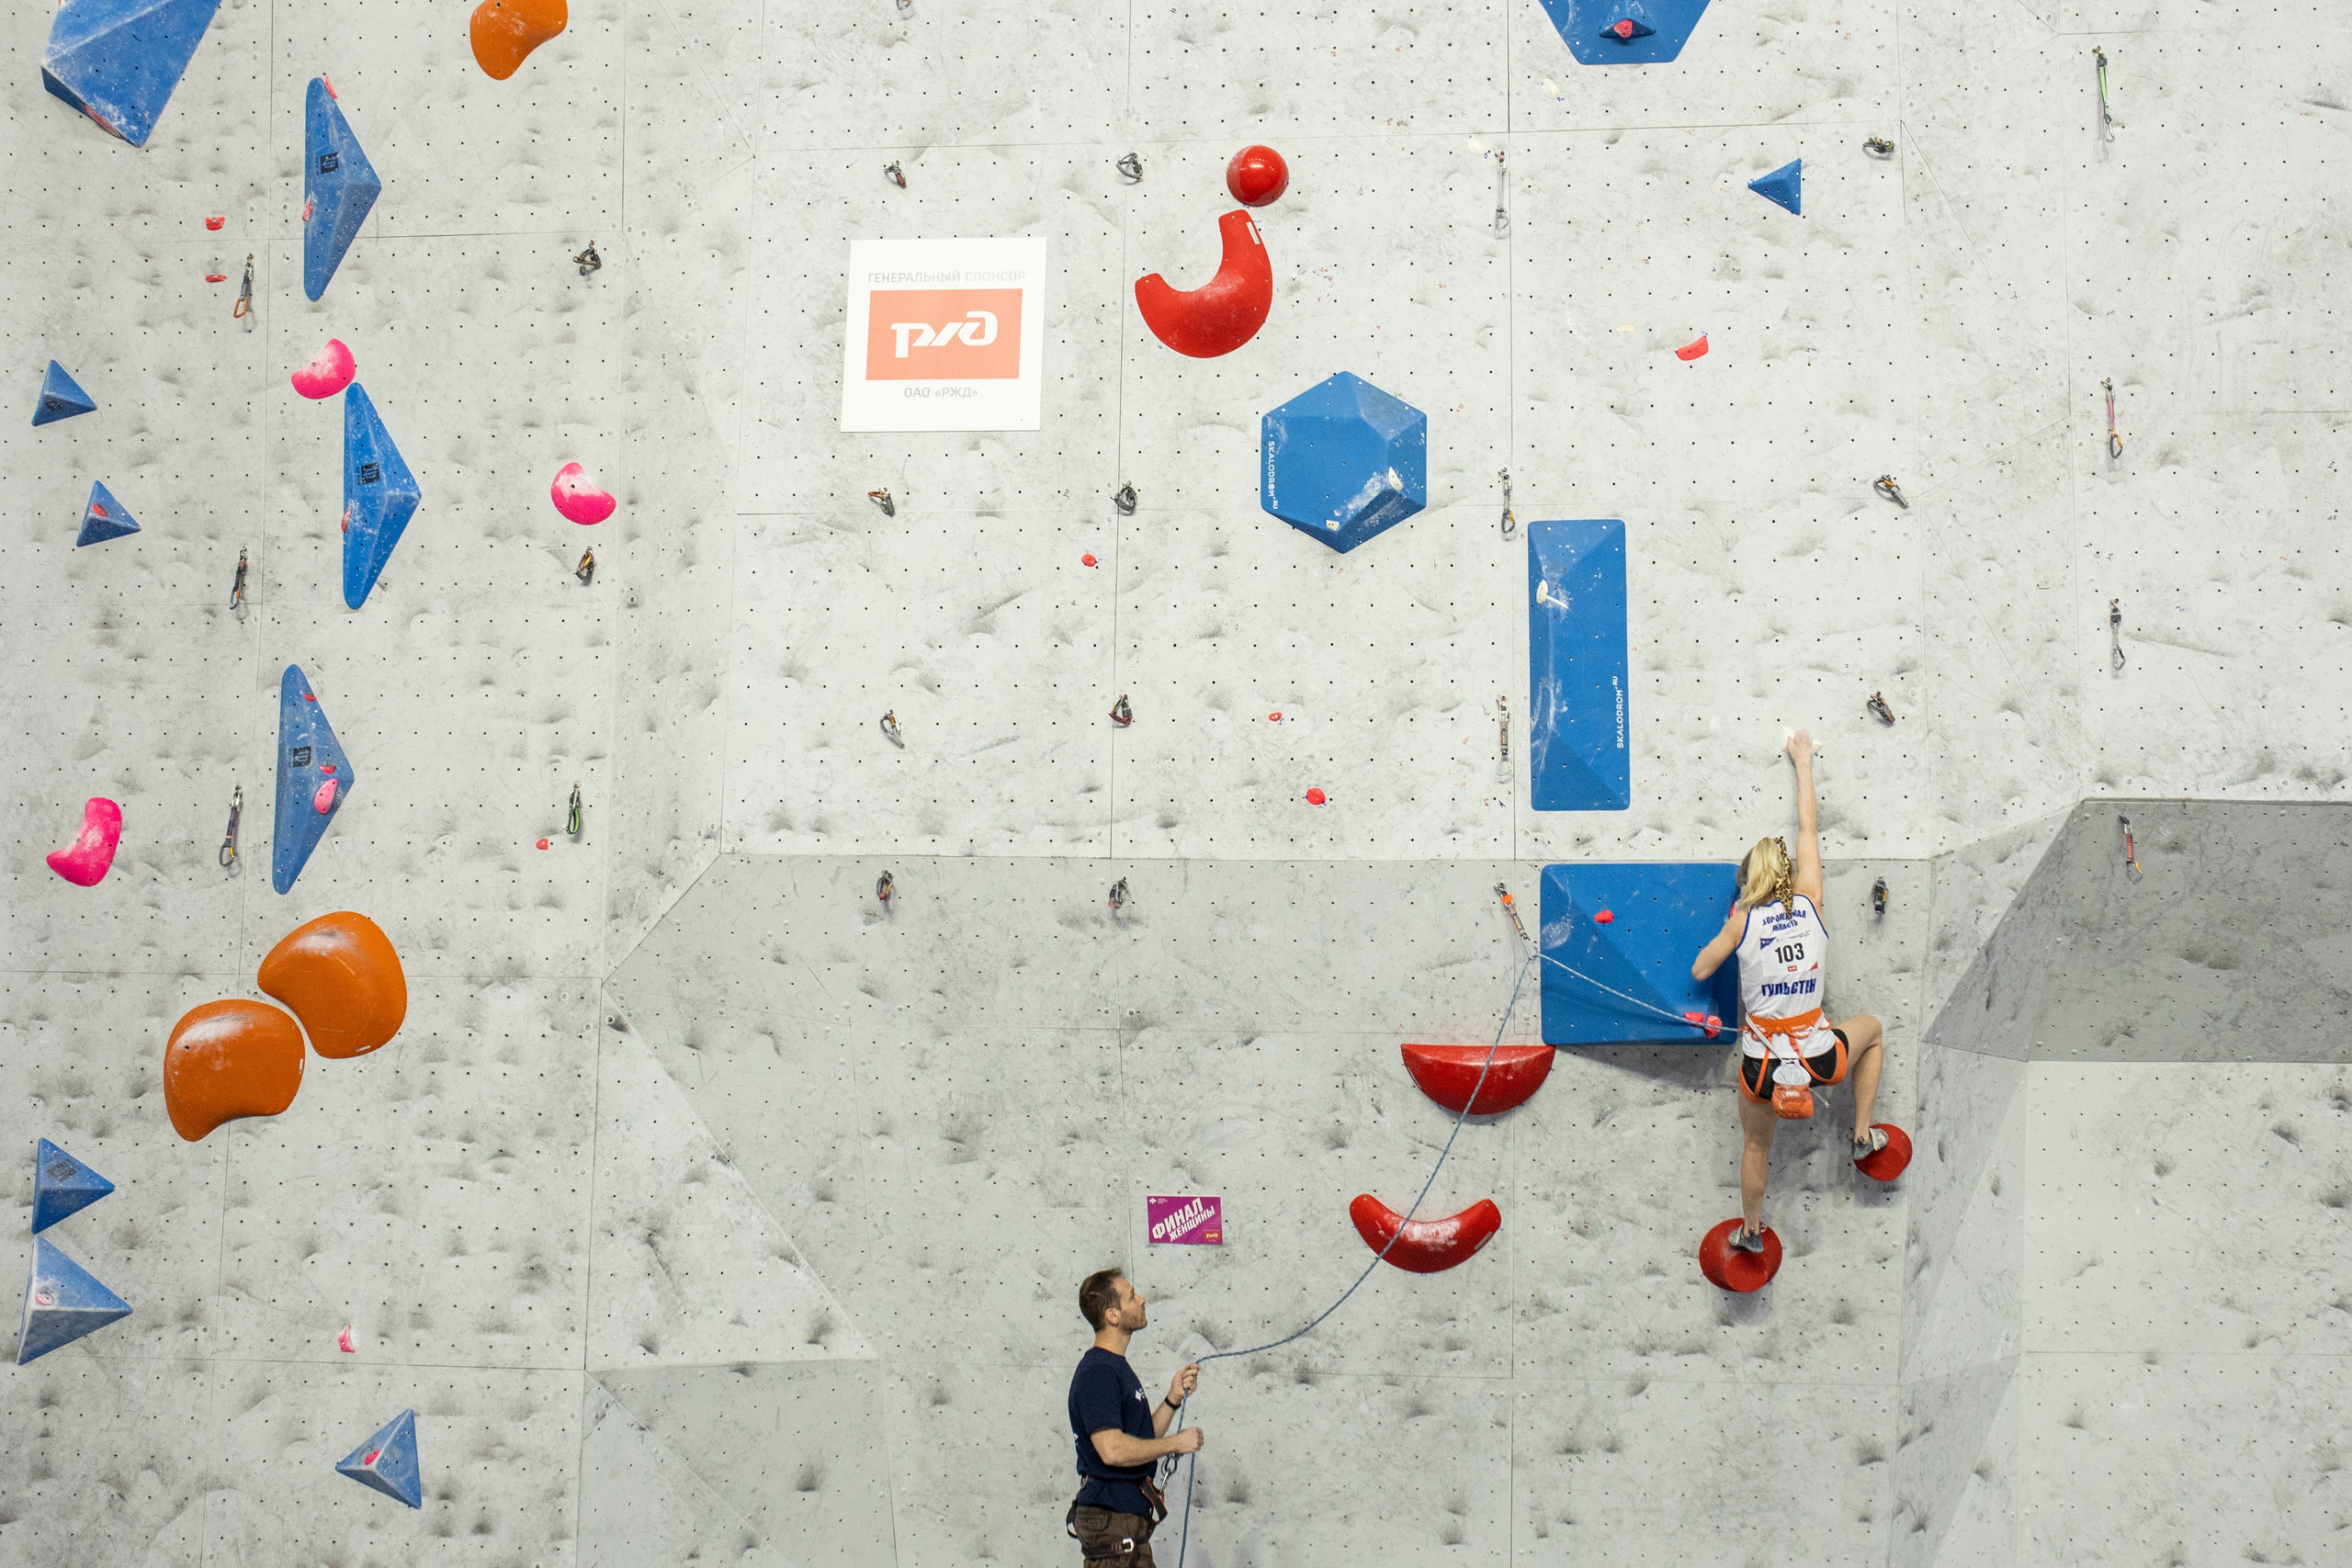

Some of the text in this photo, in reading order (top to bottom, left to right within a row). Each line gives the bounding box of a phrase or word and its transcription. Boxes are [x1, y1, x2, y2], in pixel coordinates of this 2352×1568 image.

[868, 269, 1025, 283] ГЕНЕРАЛЬНЫЙ СПОНСОР
[904, 387, 978, 400] ОАО «РЖД»
[1774, 942, 1804, 964] 103
[1151, 1197, 1204, 1239] ФИНАЛ
[1168, 1205, 1216, 1242] ЖЕНЩИНЫ
